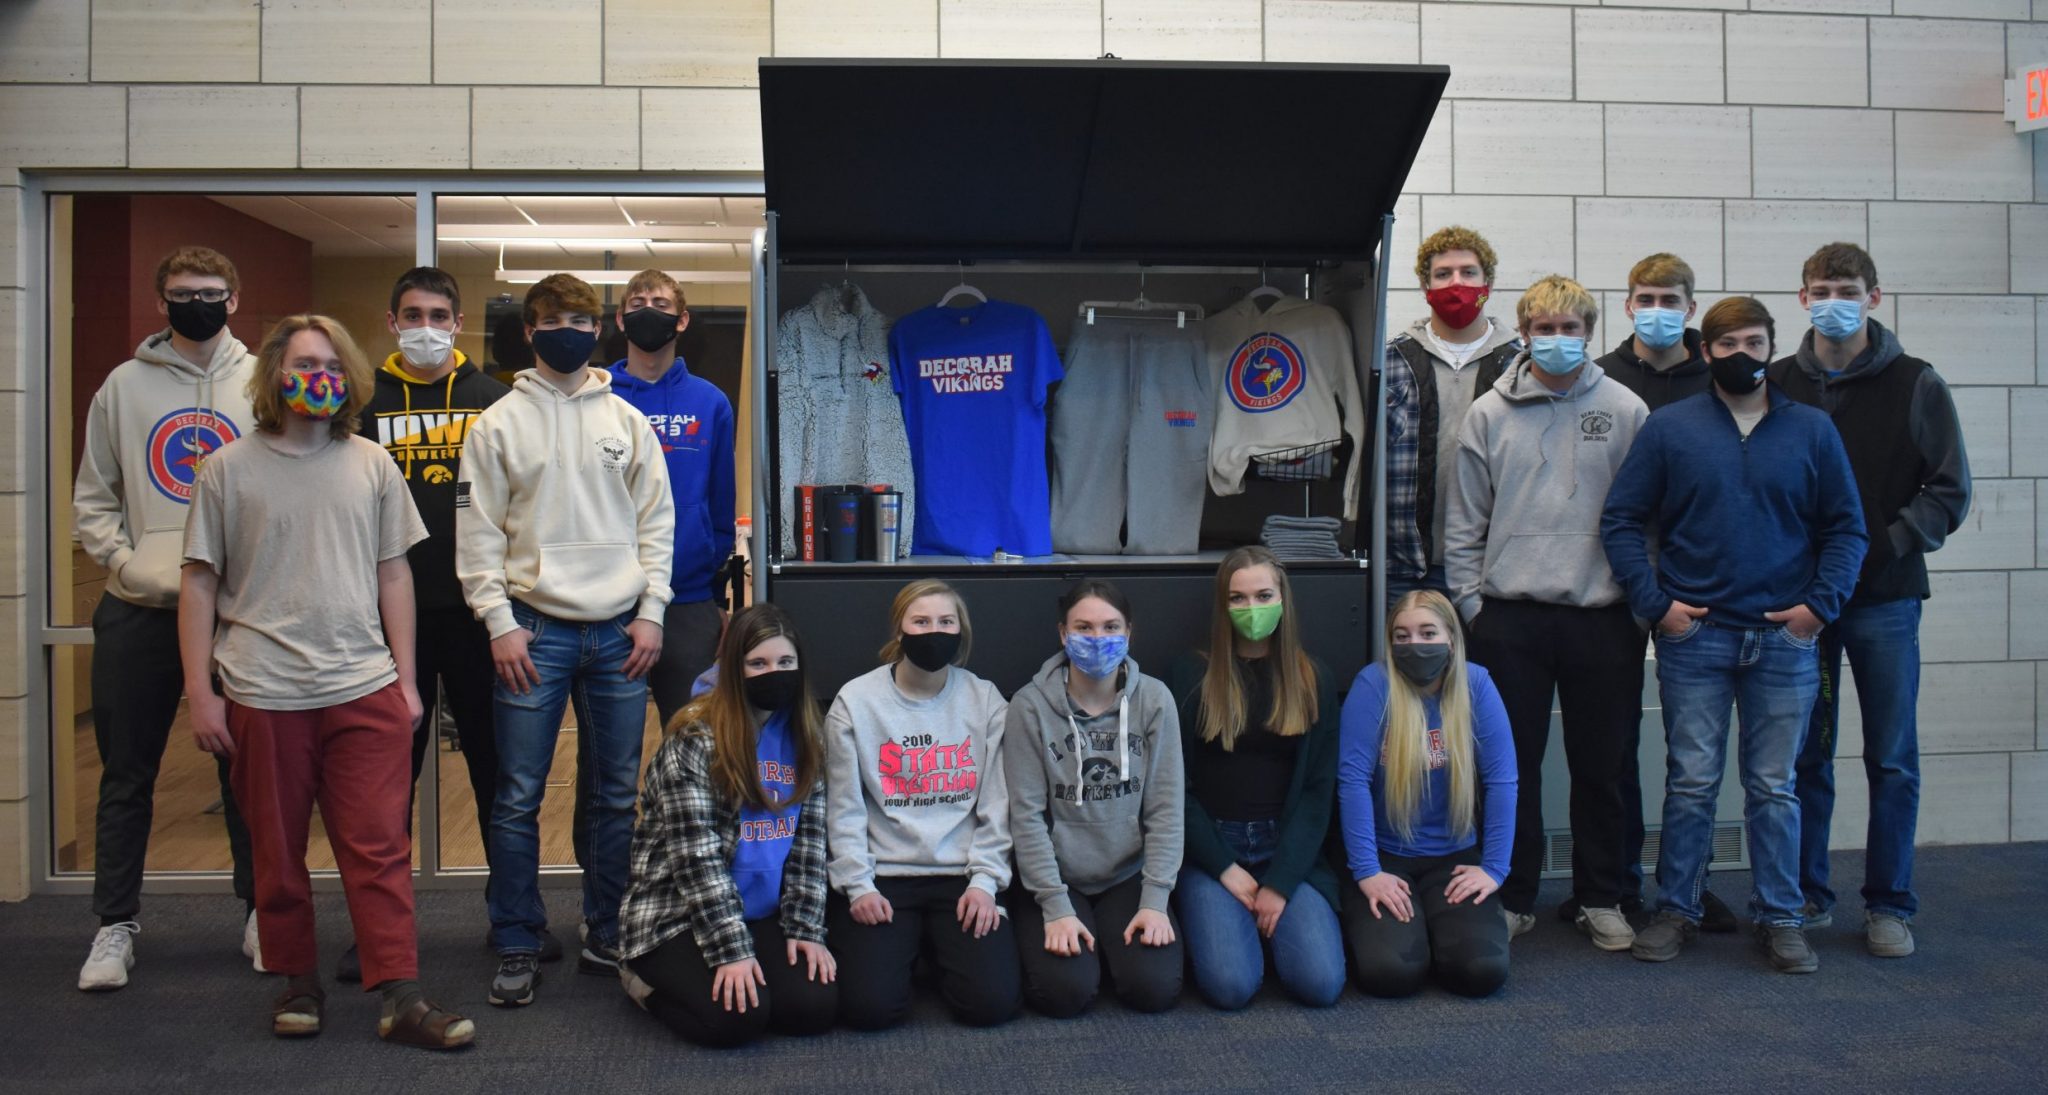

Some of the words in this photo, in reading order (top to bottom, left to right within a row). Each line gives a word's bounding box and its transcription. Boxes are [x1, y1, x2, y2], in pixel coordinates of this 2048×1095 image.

[919, 354, 1013, 377] DECORAH
[932, 374, 1005, 394] VIKINGS
[804, 496, 812, 529] GRIP
[805, 534, 813, 560] ONE
[902, 733, 932, 748] 2018
[879, 735, 977, 777] STATE
[884, 796, 910, 807] IOWA
[940, 791, 972, 805] SCHOOL
